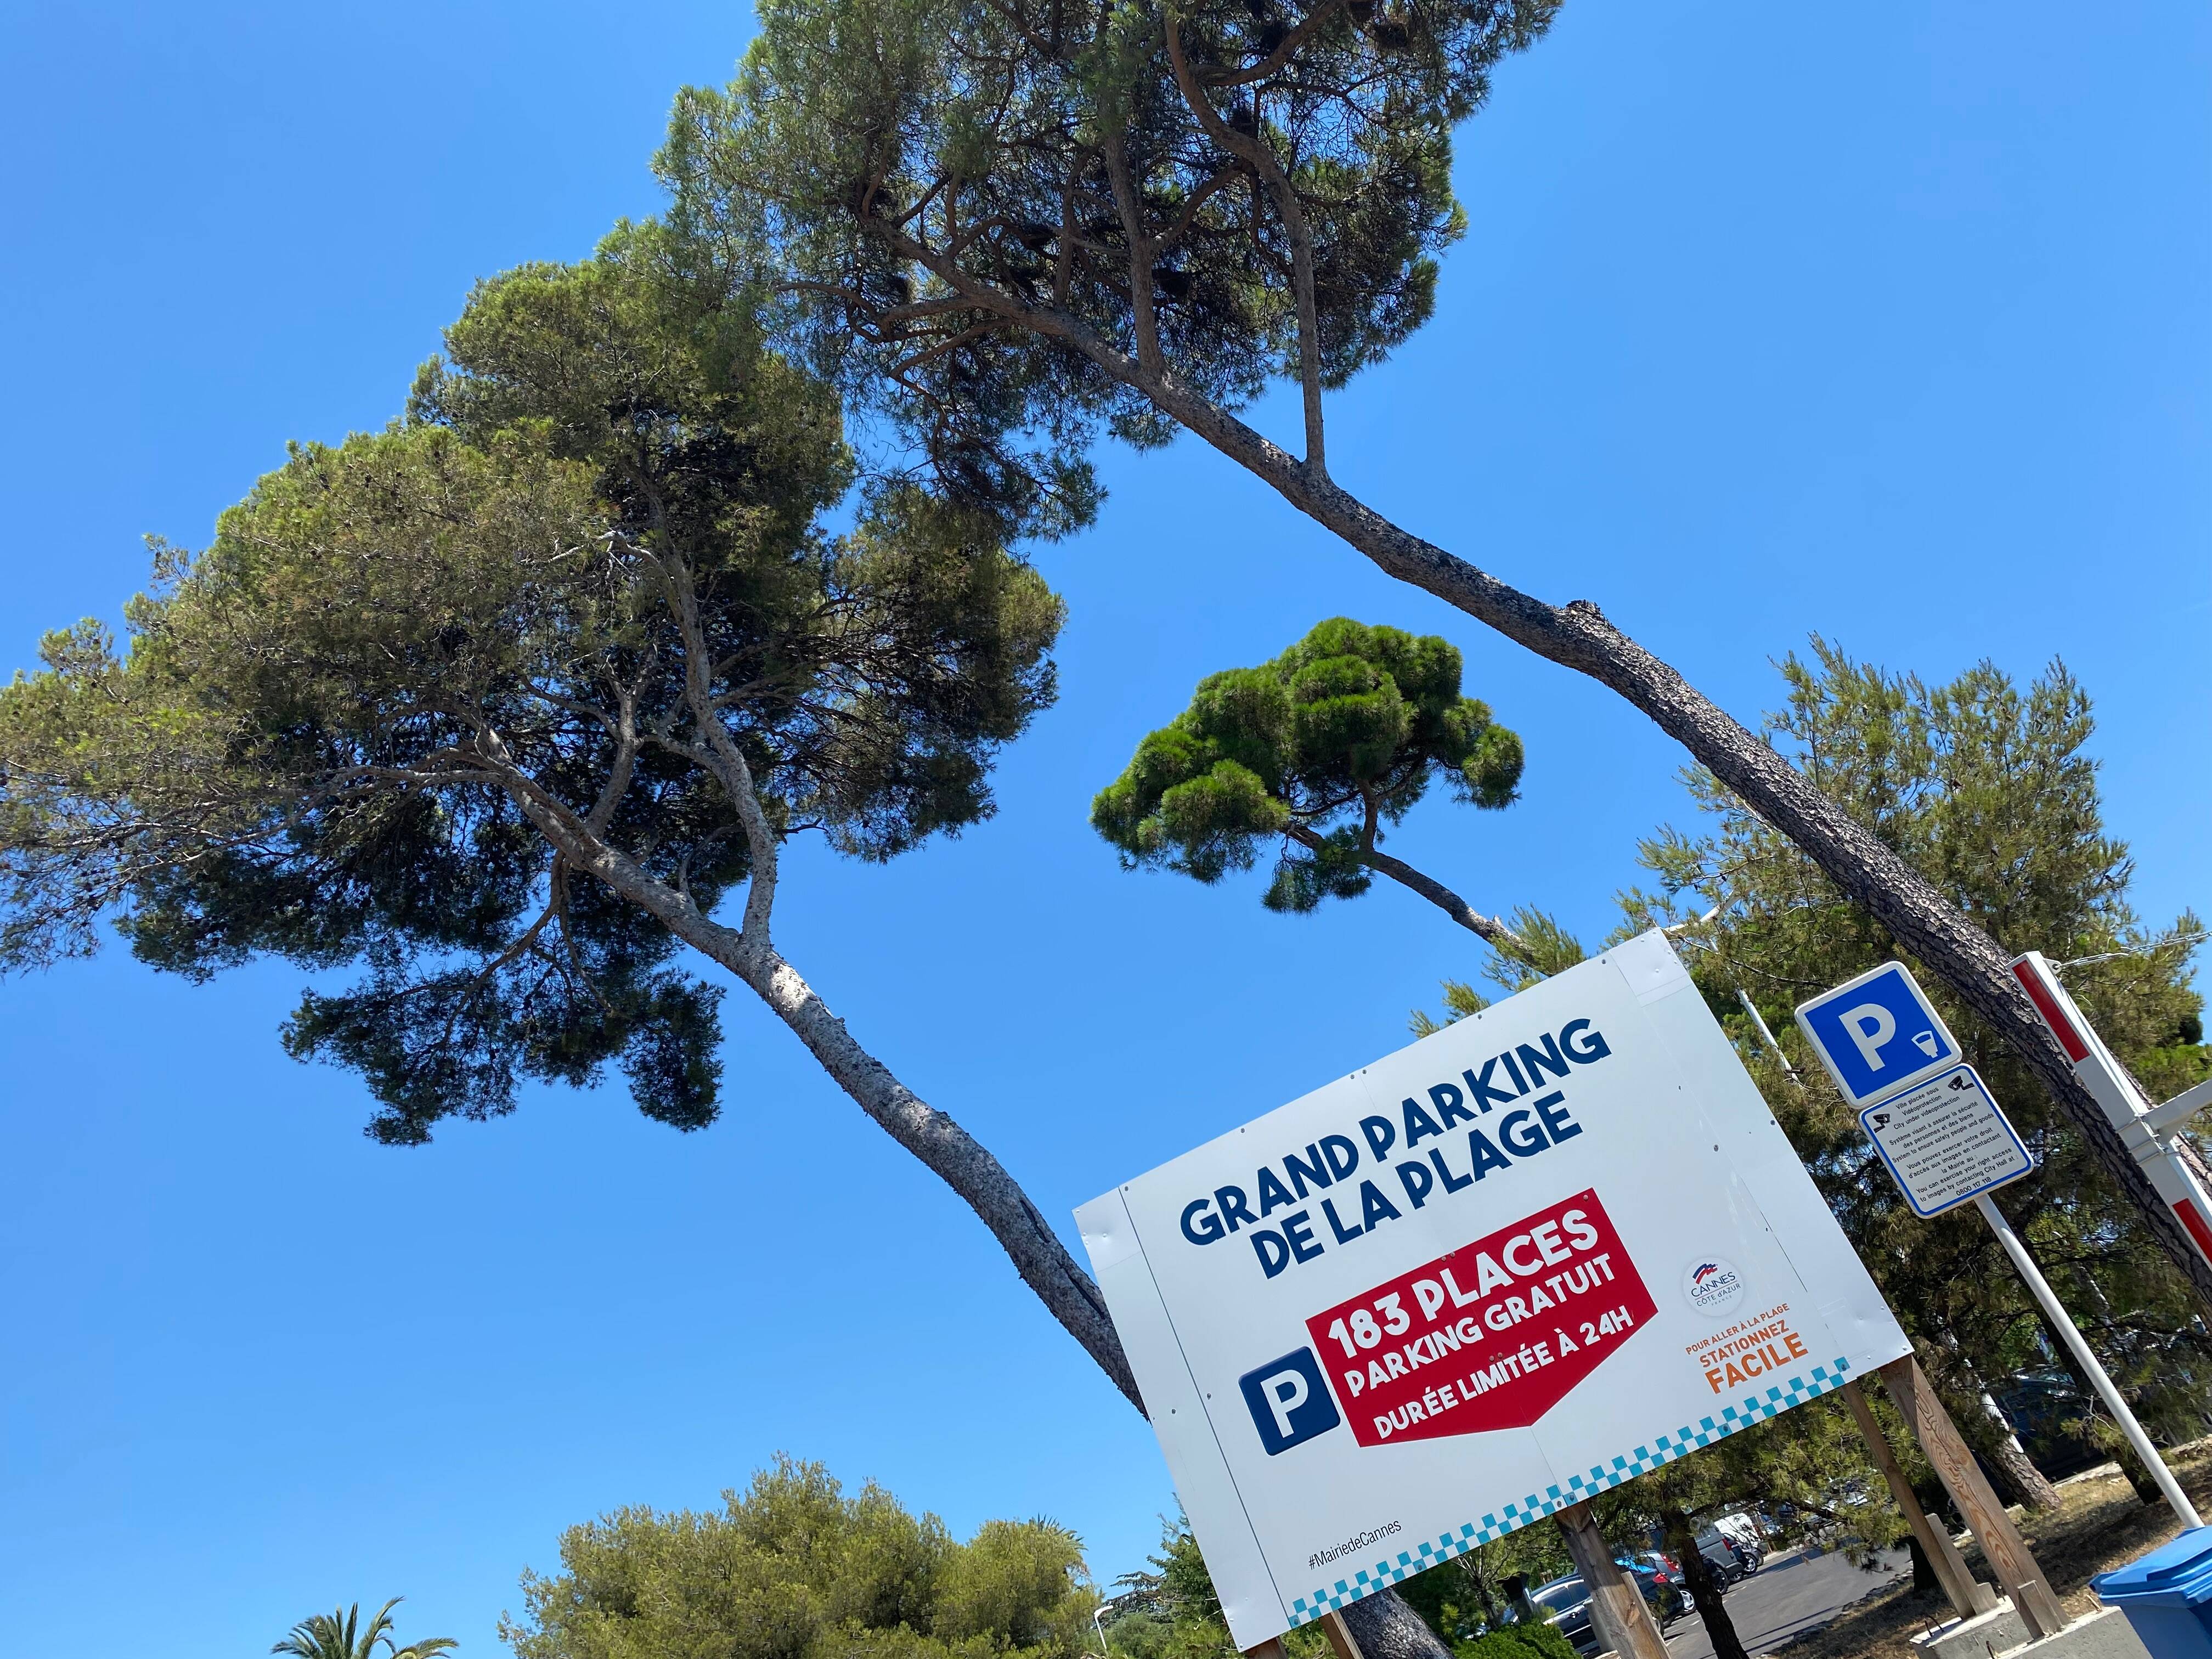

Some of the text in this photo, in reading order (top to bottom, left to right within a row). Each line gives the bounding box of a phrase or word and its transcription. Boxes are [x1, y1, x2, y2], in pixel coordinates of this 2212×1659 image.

[1838, 1003, 1896, 1072] P
[1902, 1095, 1942, 1116] Vidéoprotection
[1905, 1114, 1920, 1124] under
[1921, 1096, 1960, 1119] videoprotection
[1909, 1093, 1925, 1105] placée
[1180, 1019, 1612, 1245] GRAND PARKING
[1889, 1132, 1911, 1146] Système
[1912, 1125, 1927, 1135] visant
[1933, 1114, 1951, 1126] assurer
[1958, 1101, 1978, 1114] sécurité
[1892, 1152, 1910, 1163] System
[1918, 1141, 1934, 1151] ensure
[1934, 1133, 1950, 1143] safety
[1951, 1125, 1967, 1137] people
[1979, 1113, 1994, 1124] goods
[1903, 1141, 1913, 1149] des
[1914, 1129, 1940, 1144] personnes
[1949, 1119, 1958, 1127] des
[1959, 1113, 1974, 1122] biens
[1906, 1127, 1993, 1170] Vous pouvez exercer votre droit
[1909, 1166, 1929, 1179] d'accès
[1942, 1152, 1962, 1164] images
[1972, 1133, 2001, 1150] contactant
[1940, 1171, 1963, 1183] exercise
[1964, 1164, 1977, 1173] your
[1978, 1157, 1991, 1167] right
[1991, 1148, 2012, 1159] access
[1948, 1159, 1965, 1170] Mairie
[1250, 1090, 1582, 1279] DE LA PLAGE
[1928, 1188, 1946, 1199] images
[1956, 1171, 1984, 1186] contacting
[1984, 1164, 1996, 1173] City
[1996, 1159, 2007, 1167] Hall
[1956, 1186, 1972, 1196] 0800
[1982, 1176, 1991, 1184] 118
[1328, 1210, 1599, 1358] 183 PLACES
[1691, 1272, 1735, 1297] CANNES
[1697, 1283, 1741, 1306] CÔTE d'AZUR
[1345, 1254, 1615, 1397] PARKING GRATUIT
[1686, 1303, 1790, 1355] POUR ALLER À LA PLAGE
[1700, 1320, 1789, 1368] STATIONNEZ
[1374, 1305, 1634, 1438] DURÉE LIMITÉE À 24H
[1705, 1332, 1809, 1395] FACILE
[1260, 1369, 1308, 1438] P
[1308, 1520, 1401, 1570] #MairiedeCannes
